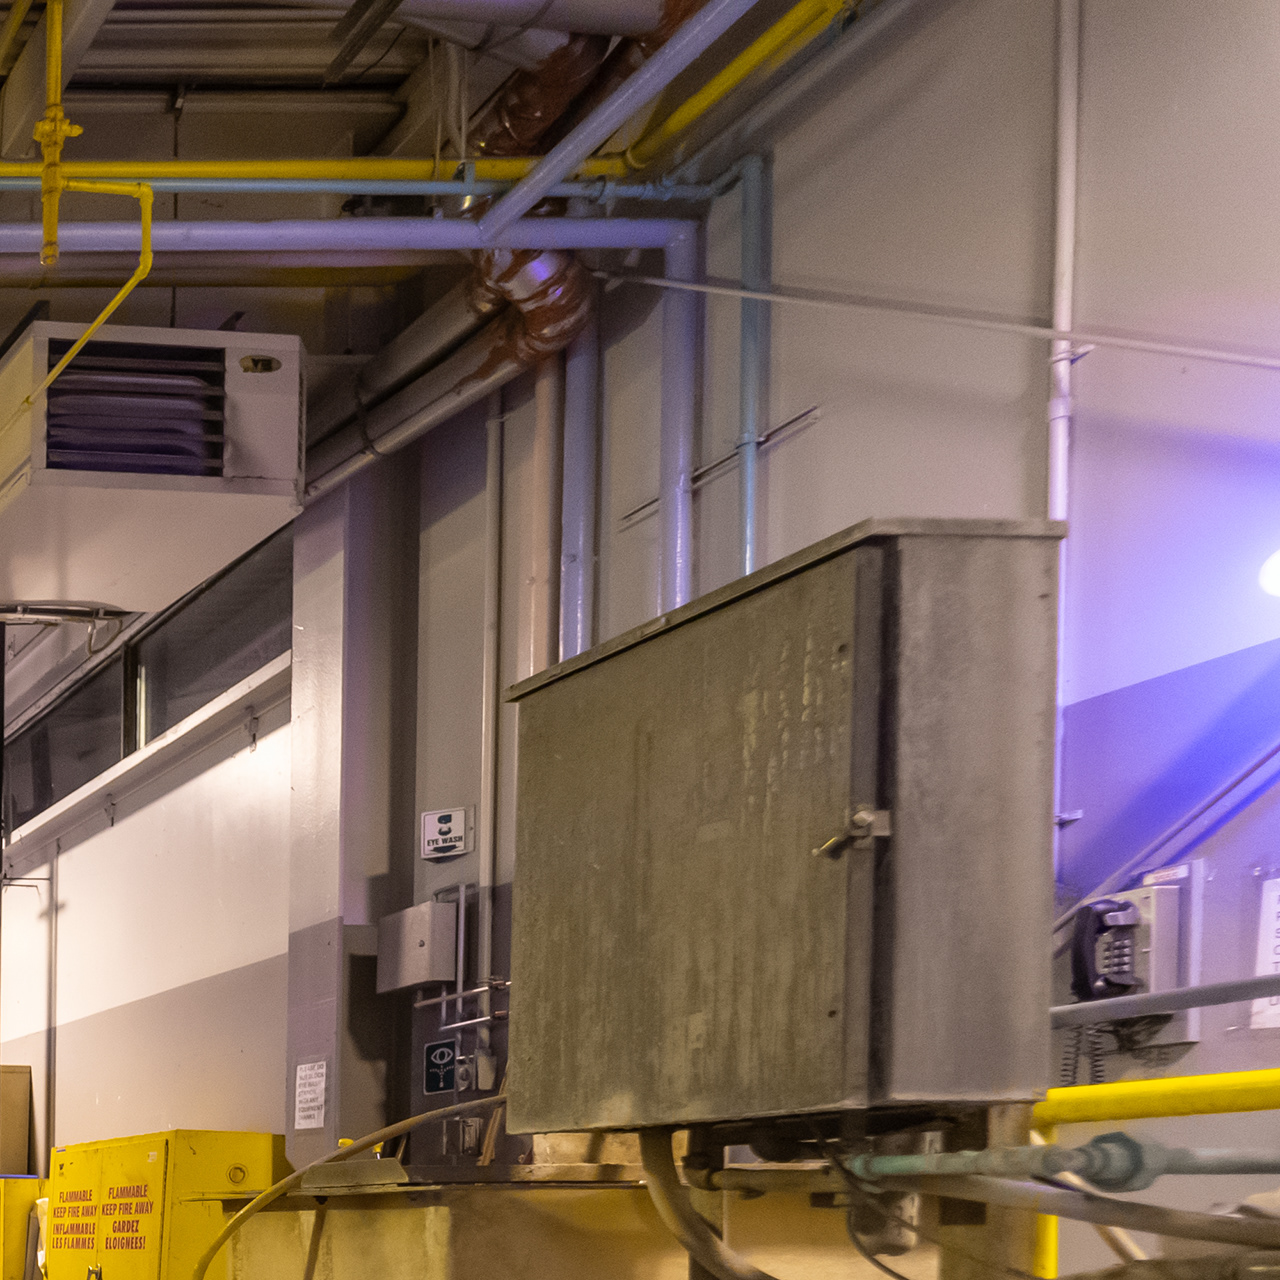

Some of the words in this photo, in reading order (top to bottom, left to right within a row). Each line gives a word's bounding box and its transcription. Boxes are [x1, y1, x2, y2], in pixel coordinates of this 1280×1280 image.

[442, 836, 463, 844] WASH
[59, 1189, 93, 1203] FLAMMABLE
[108, 1184, 148, 1199] FLAMMABLE
[53, 1206, 67, 1218] KEEP
[68, 1206, 80, 1217] FIRE
[81, 1204, 98, 1217] AWAY
[101, 1203, 117, 1216] KEEP
[119, 1202, 133, 1215] FIRE
[134, 1201, 154, 1214] AWAY
[53, 1222, 96, 1235] INFLAMMABLE
[112, 1219, 140, 1233] GARDEZ
[52, 1237, 63, 1249] LES
[63, 1237, 95, 1249] FLAMMES
[105, 1236, 146, 1250] ELOIGNEES!
